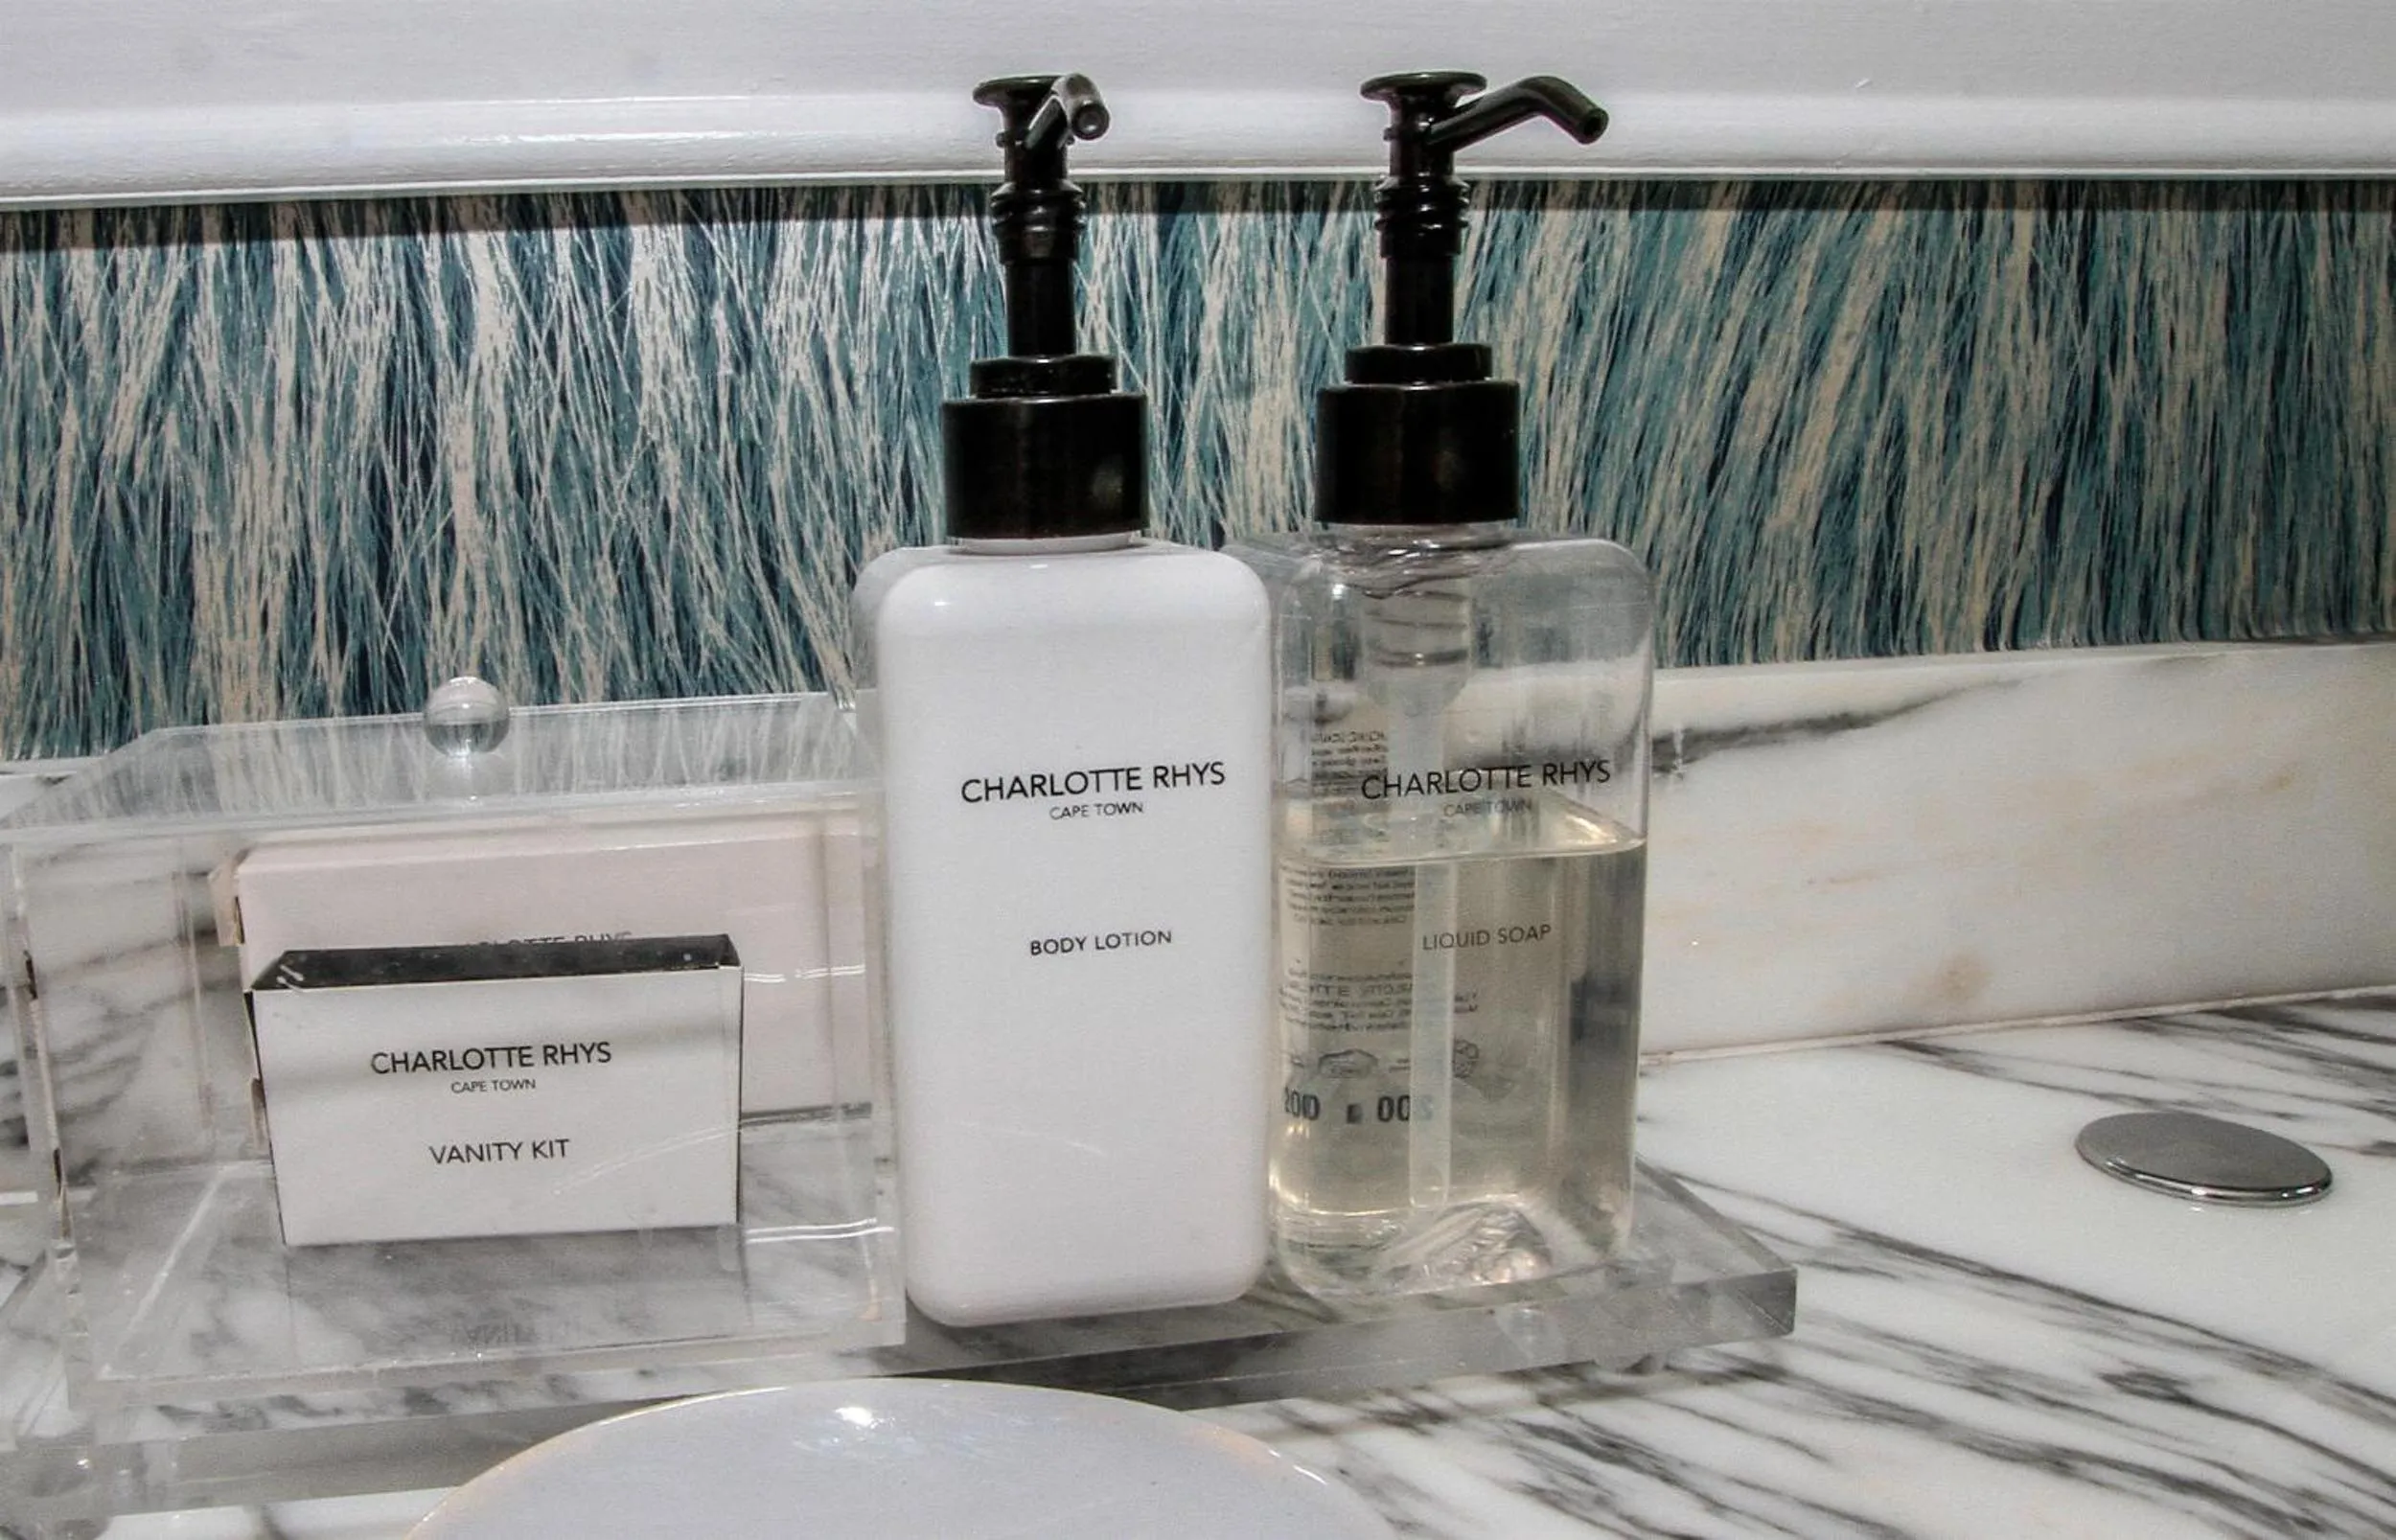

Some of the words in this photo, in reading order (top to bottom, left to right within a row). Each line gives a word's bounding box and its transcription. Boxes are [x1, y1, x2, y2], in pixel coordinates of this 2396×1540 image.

[961, 768, 1142, 803] CHARLOTTE
[1153, 762, 1226, 789] RHYS
[1361, 765, 1532, 800] CHARLOTTE
[1541, 760, 1611, 786] RHYS
[1049, 806, 1089, 820] CAPE
[1095, 803, 1143, 816] TOWN
[1443, 803, 1482, 817] CAPE
[1030, 935, 1087, 956] BODY
[1094, 931, 1172, 951] LOTION
[1422, 931, 1490, 951] LIQUID
[1497, 925, 1552, 943] SOAP
[370, 1046, 535, 1074] CHARLOTTE
[542, 1042, 611, 1066] RHYS
[451, 1080, 488, 1093] CAPE
[492, 1078, 536, 1092] TOWN
[429, 1142, 522, 1164] VANITY
[532, 1138, 569, 1160] KIT
